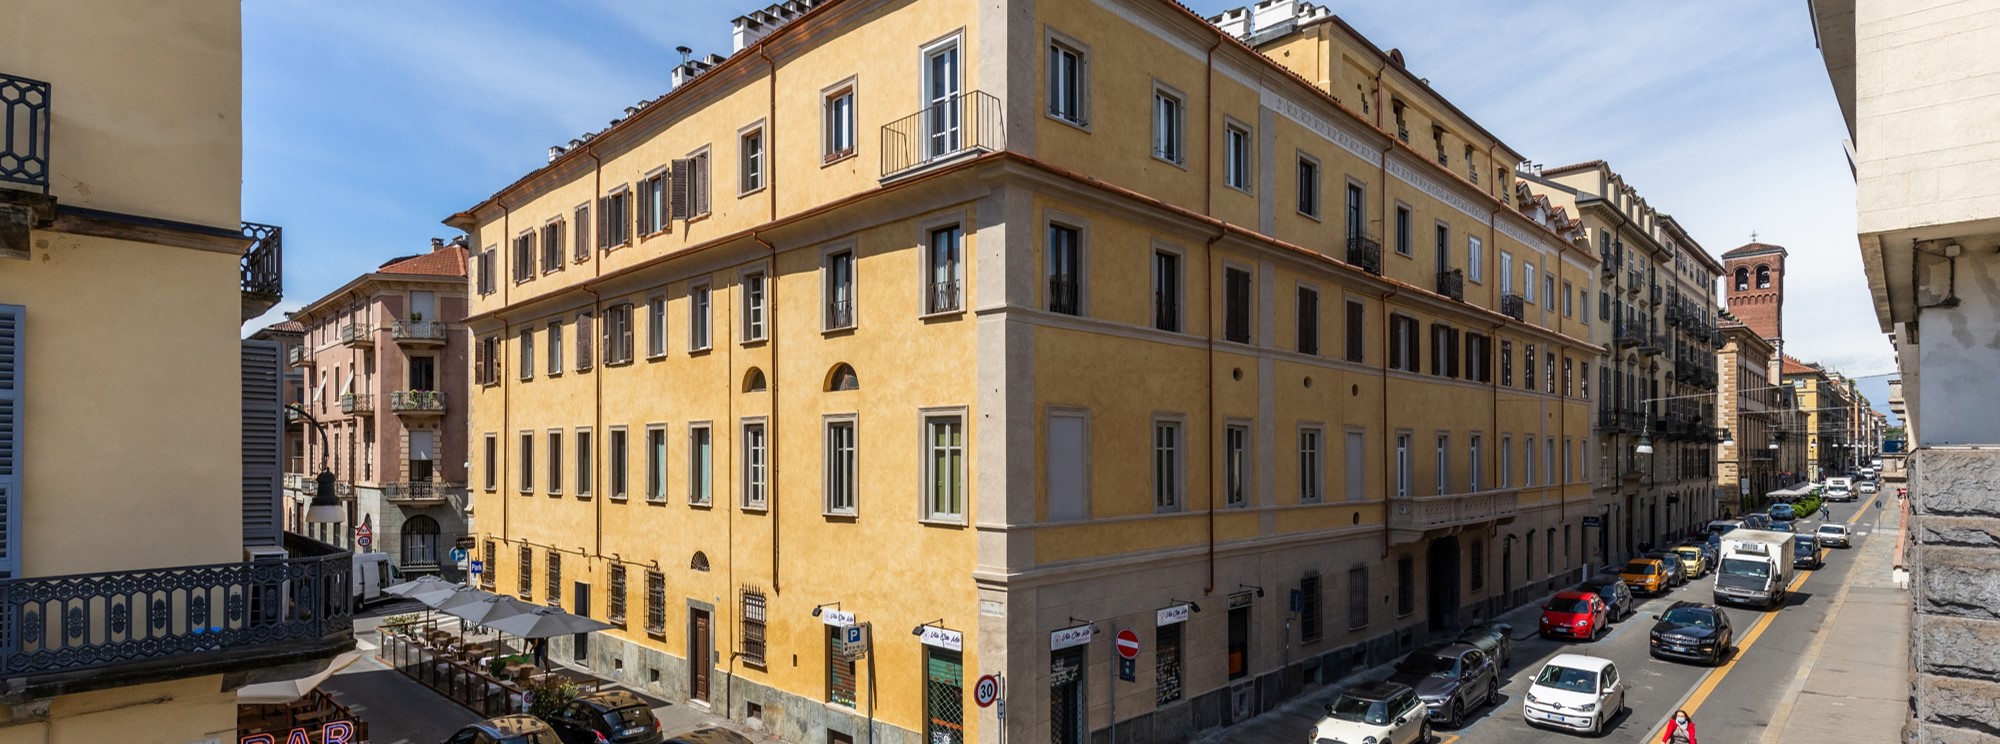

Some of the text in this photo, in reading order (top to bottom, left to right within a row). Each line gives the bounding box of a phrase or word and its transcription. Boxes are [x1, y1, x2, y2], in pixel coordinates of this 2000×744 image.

[472, 563, 482, 571] Park
[850, 629, 858, 641] P
[980, 683, 993, 699] 30
[240, 720, 354, 744] AR
